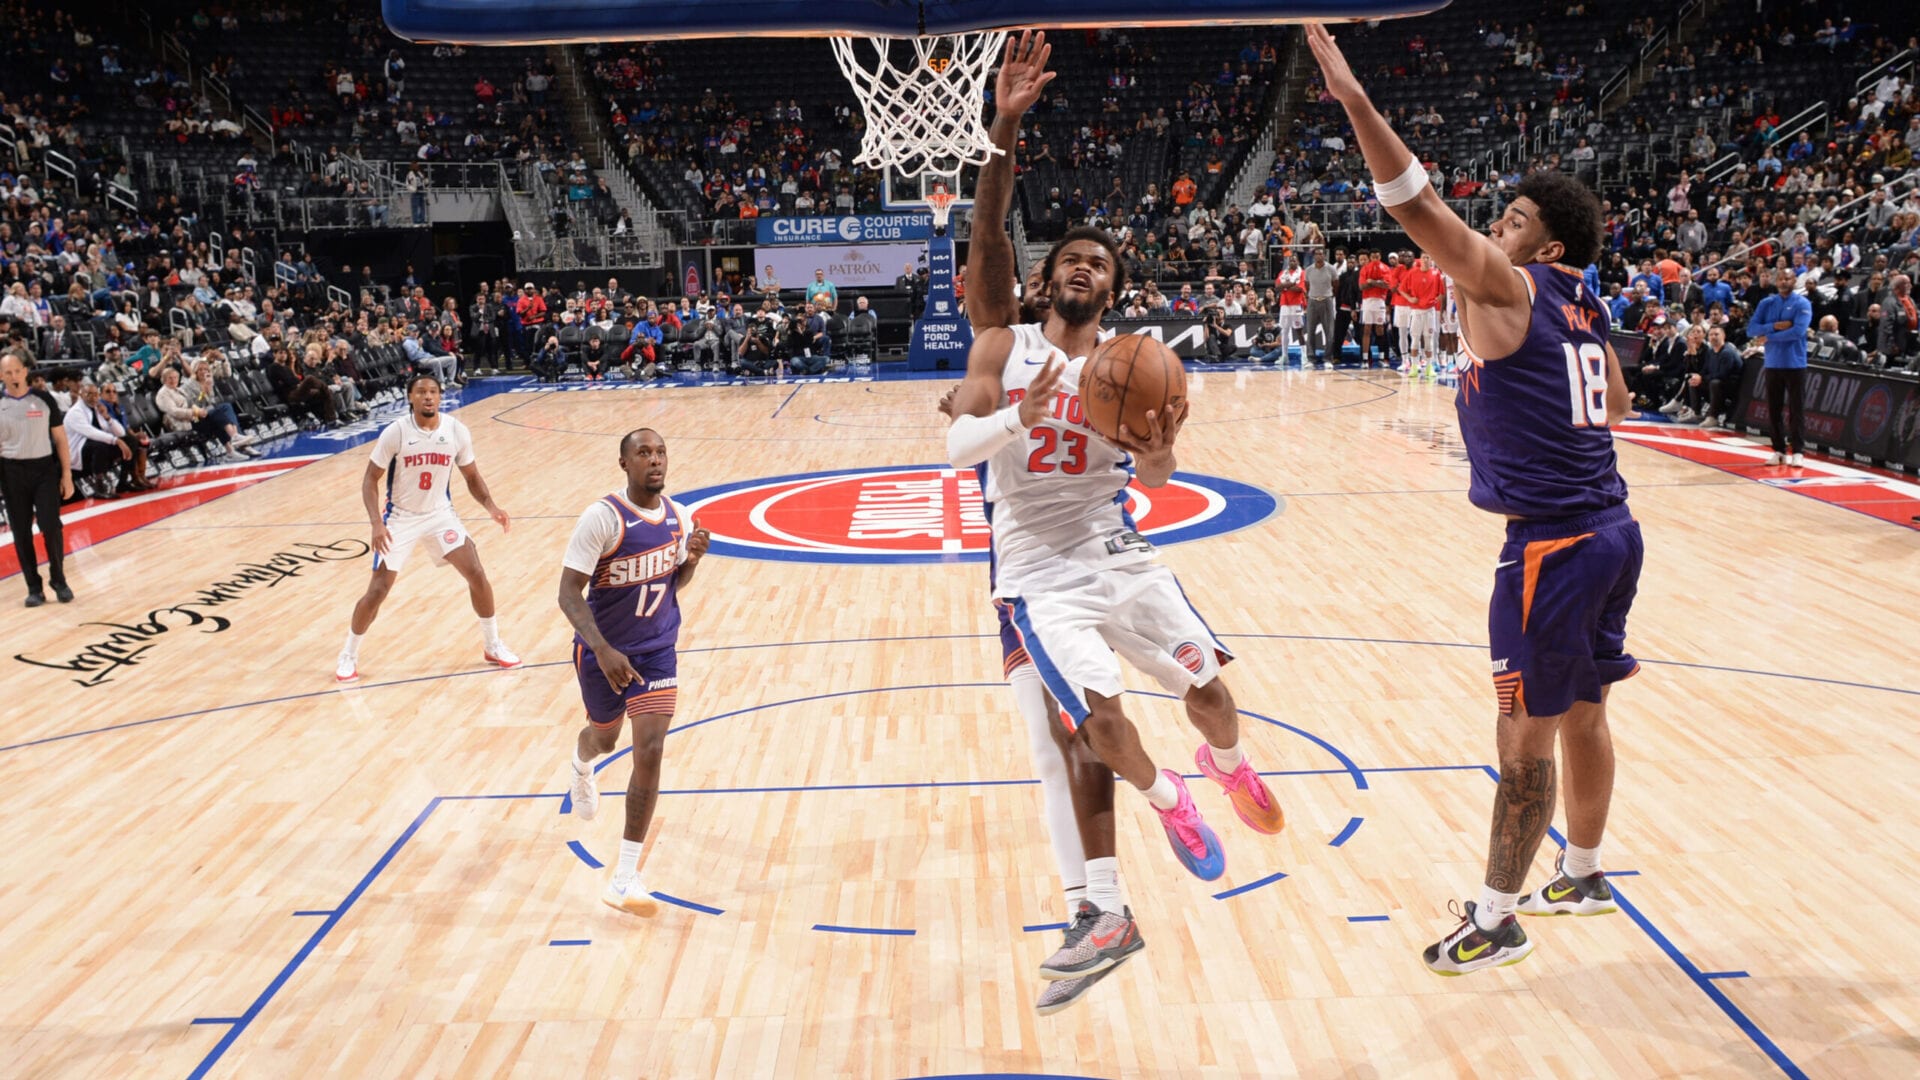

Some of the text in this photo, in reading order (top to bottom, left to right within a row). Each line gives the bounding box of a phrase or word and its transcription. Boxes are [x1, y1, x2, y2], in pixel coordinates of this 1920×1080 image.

[773, 218, 836, 234] CURE
[864, 215, 932, 228] COURTSID
[864, 227, 902, 239] CLUB
[829, 260, 880, 275] PATRÓN
[1561, 303, 1599, 334] PEAT
[922, 323, 957, 333] HENRY
[924, 332, 950, 341] FORD
[924, 341, 964, 350] HEALTH
[1561, 342, 1609, 427] 18
[1820, 375, 1861, 416] DAY
[1027, 426, 1089, 475] 23
[403, 452, 451, 468] PISTONS
[418, 471, 432, 491] 8
[847, 478, 944, 540] PISTONS
[634, 582, 667, 617] 17
[14, 538, 370, 688] Platinum Equity
